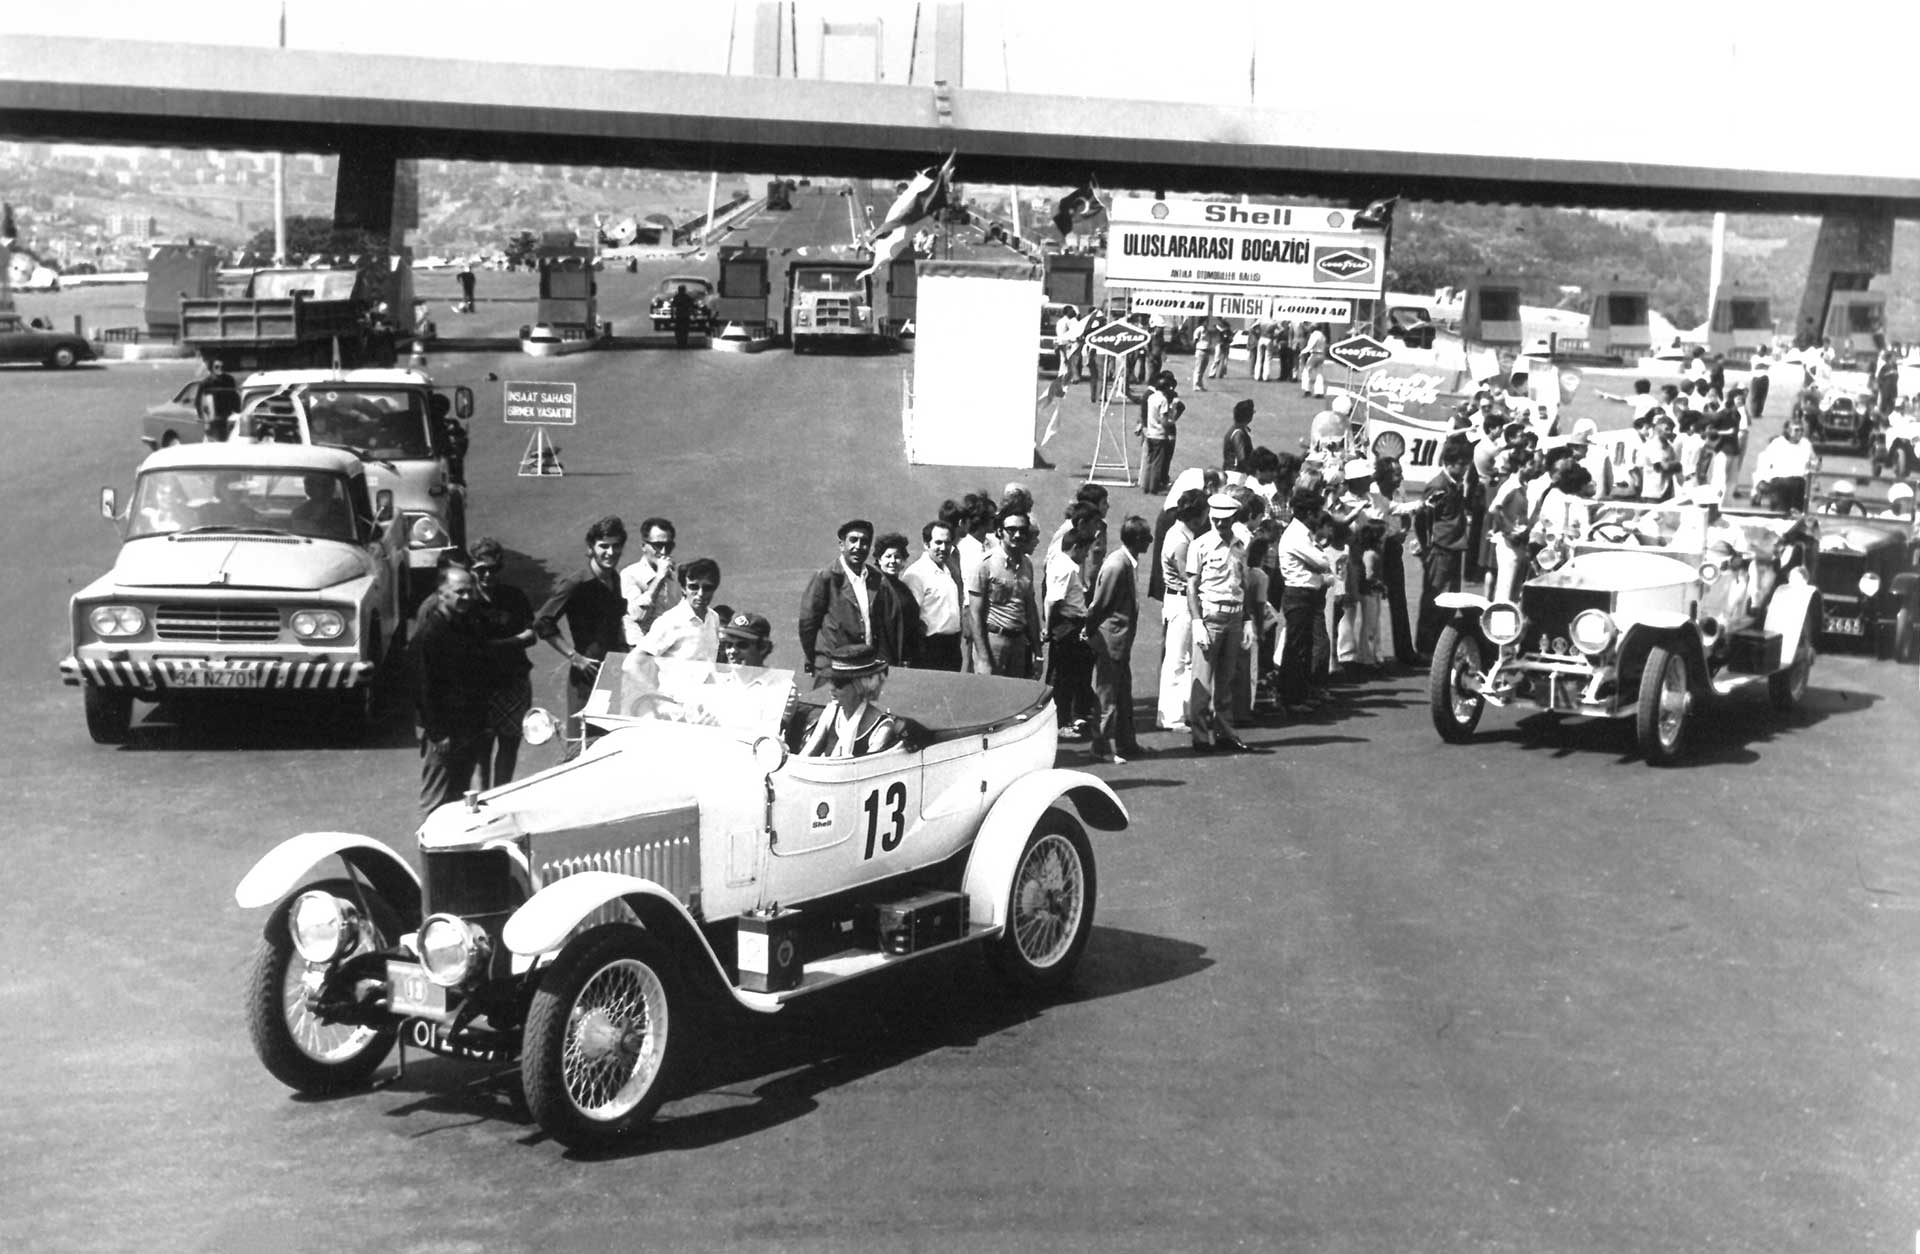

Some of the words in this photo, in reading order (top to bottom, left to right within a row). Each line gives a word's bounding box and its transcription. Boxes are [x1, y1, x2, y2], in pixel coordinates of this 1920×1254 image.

[1204, 204, 1292, 226] Shell
[1123, 233, 1234, 260] ULUSLARARASI
[1135, 297, 1206, 311] GOODYEAR
[1220, 297, 1263, 316] FINISH
[1278, 304, 1348, 317] GOODYEAR
[1090, 331, 1145, 346] GOODYEAR
[1335, 346, 1390, 359] GOODYEAR
[540, 392, 573, 404] SAHASI
[812, 819, 832, 829] Shell
[863, 781, 908, 861] 13
